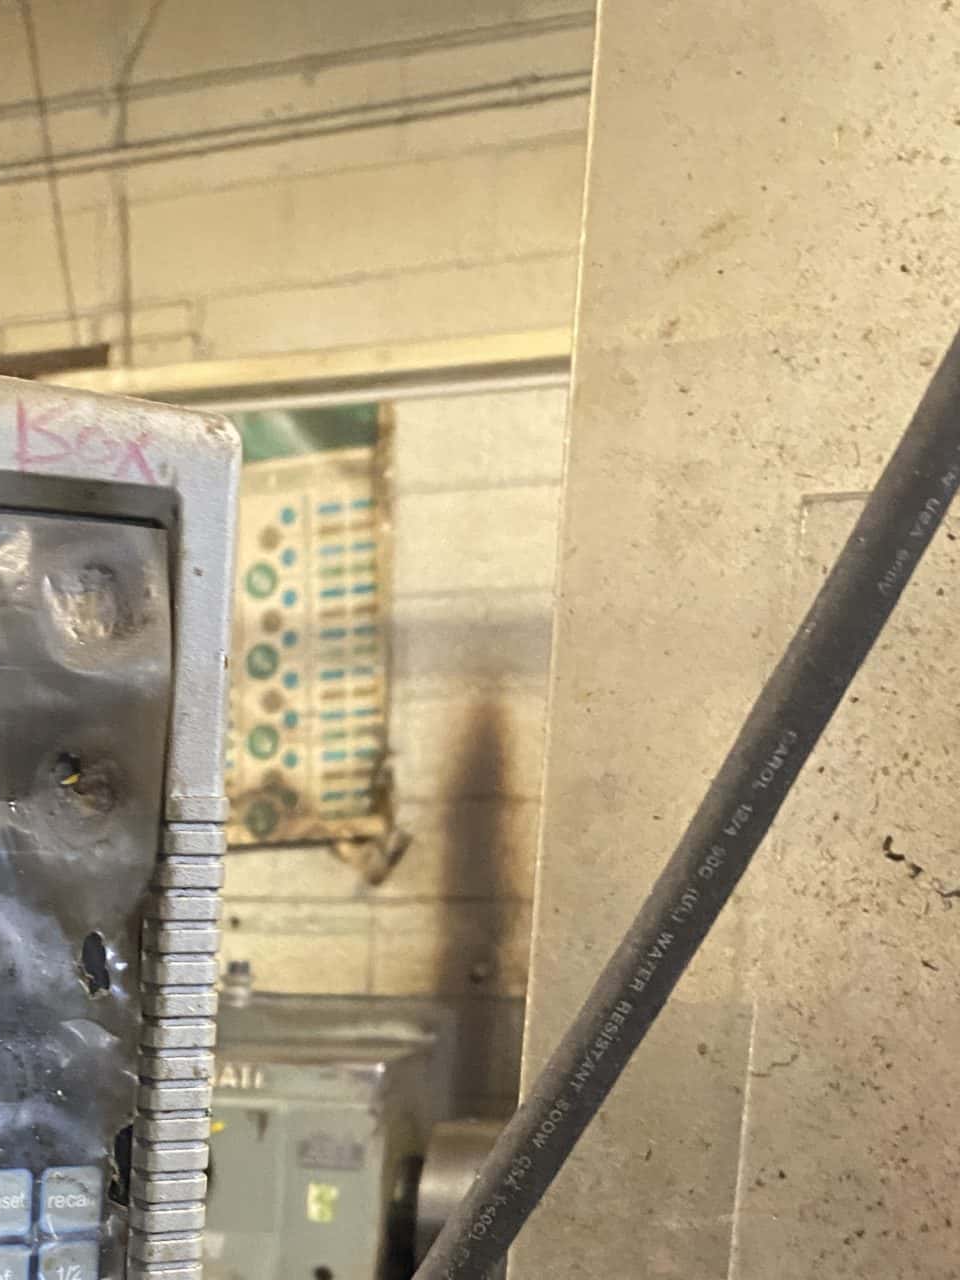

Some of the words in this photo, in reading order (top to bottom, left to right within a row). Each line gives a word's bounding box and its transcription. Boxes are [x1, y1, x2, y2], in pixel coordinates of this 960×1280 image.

[753, 727, 797, 794] CAROL
[724, 801, 752, 839] 12/4
[698, 844, 726, 882] 90C
[672, 886, 699, 925] (UL)
[629, 930, 672, 993] WATER
[566, 999, 633, 1092] RESISTANT
[531, 1098, 568, 1149] SOOW
